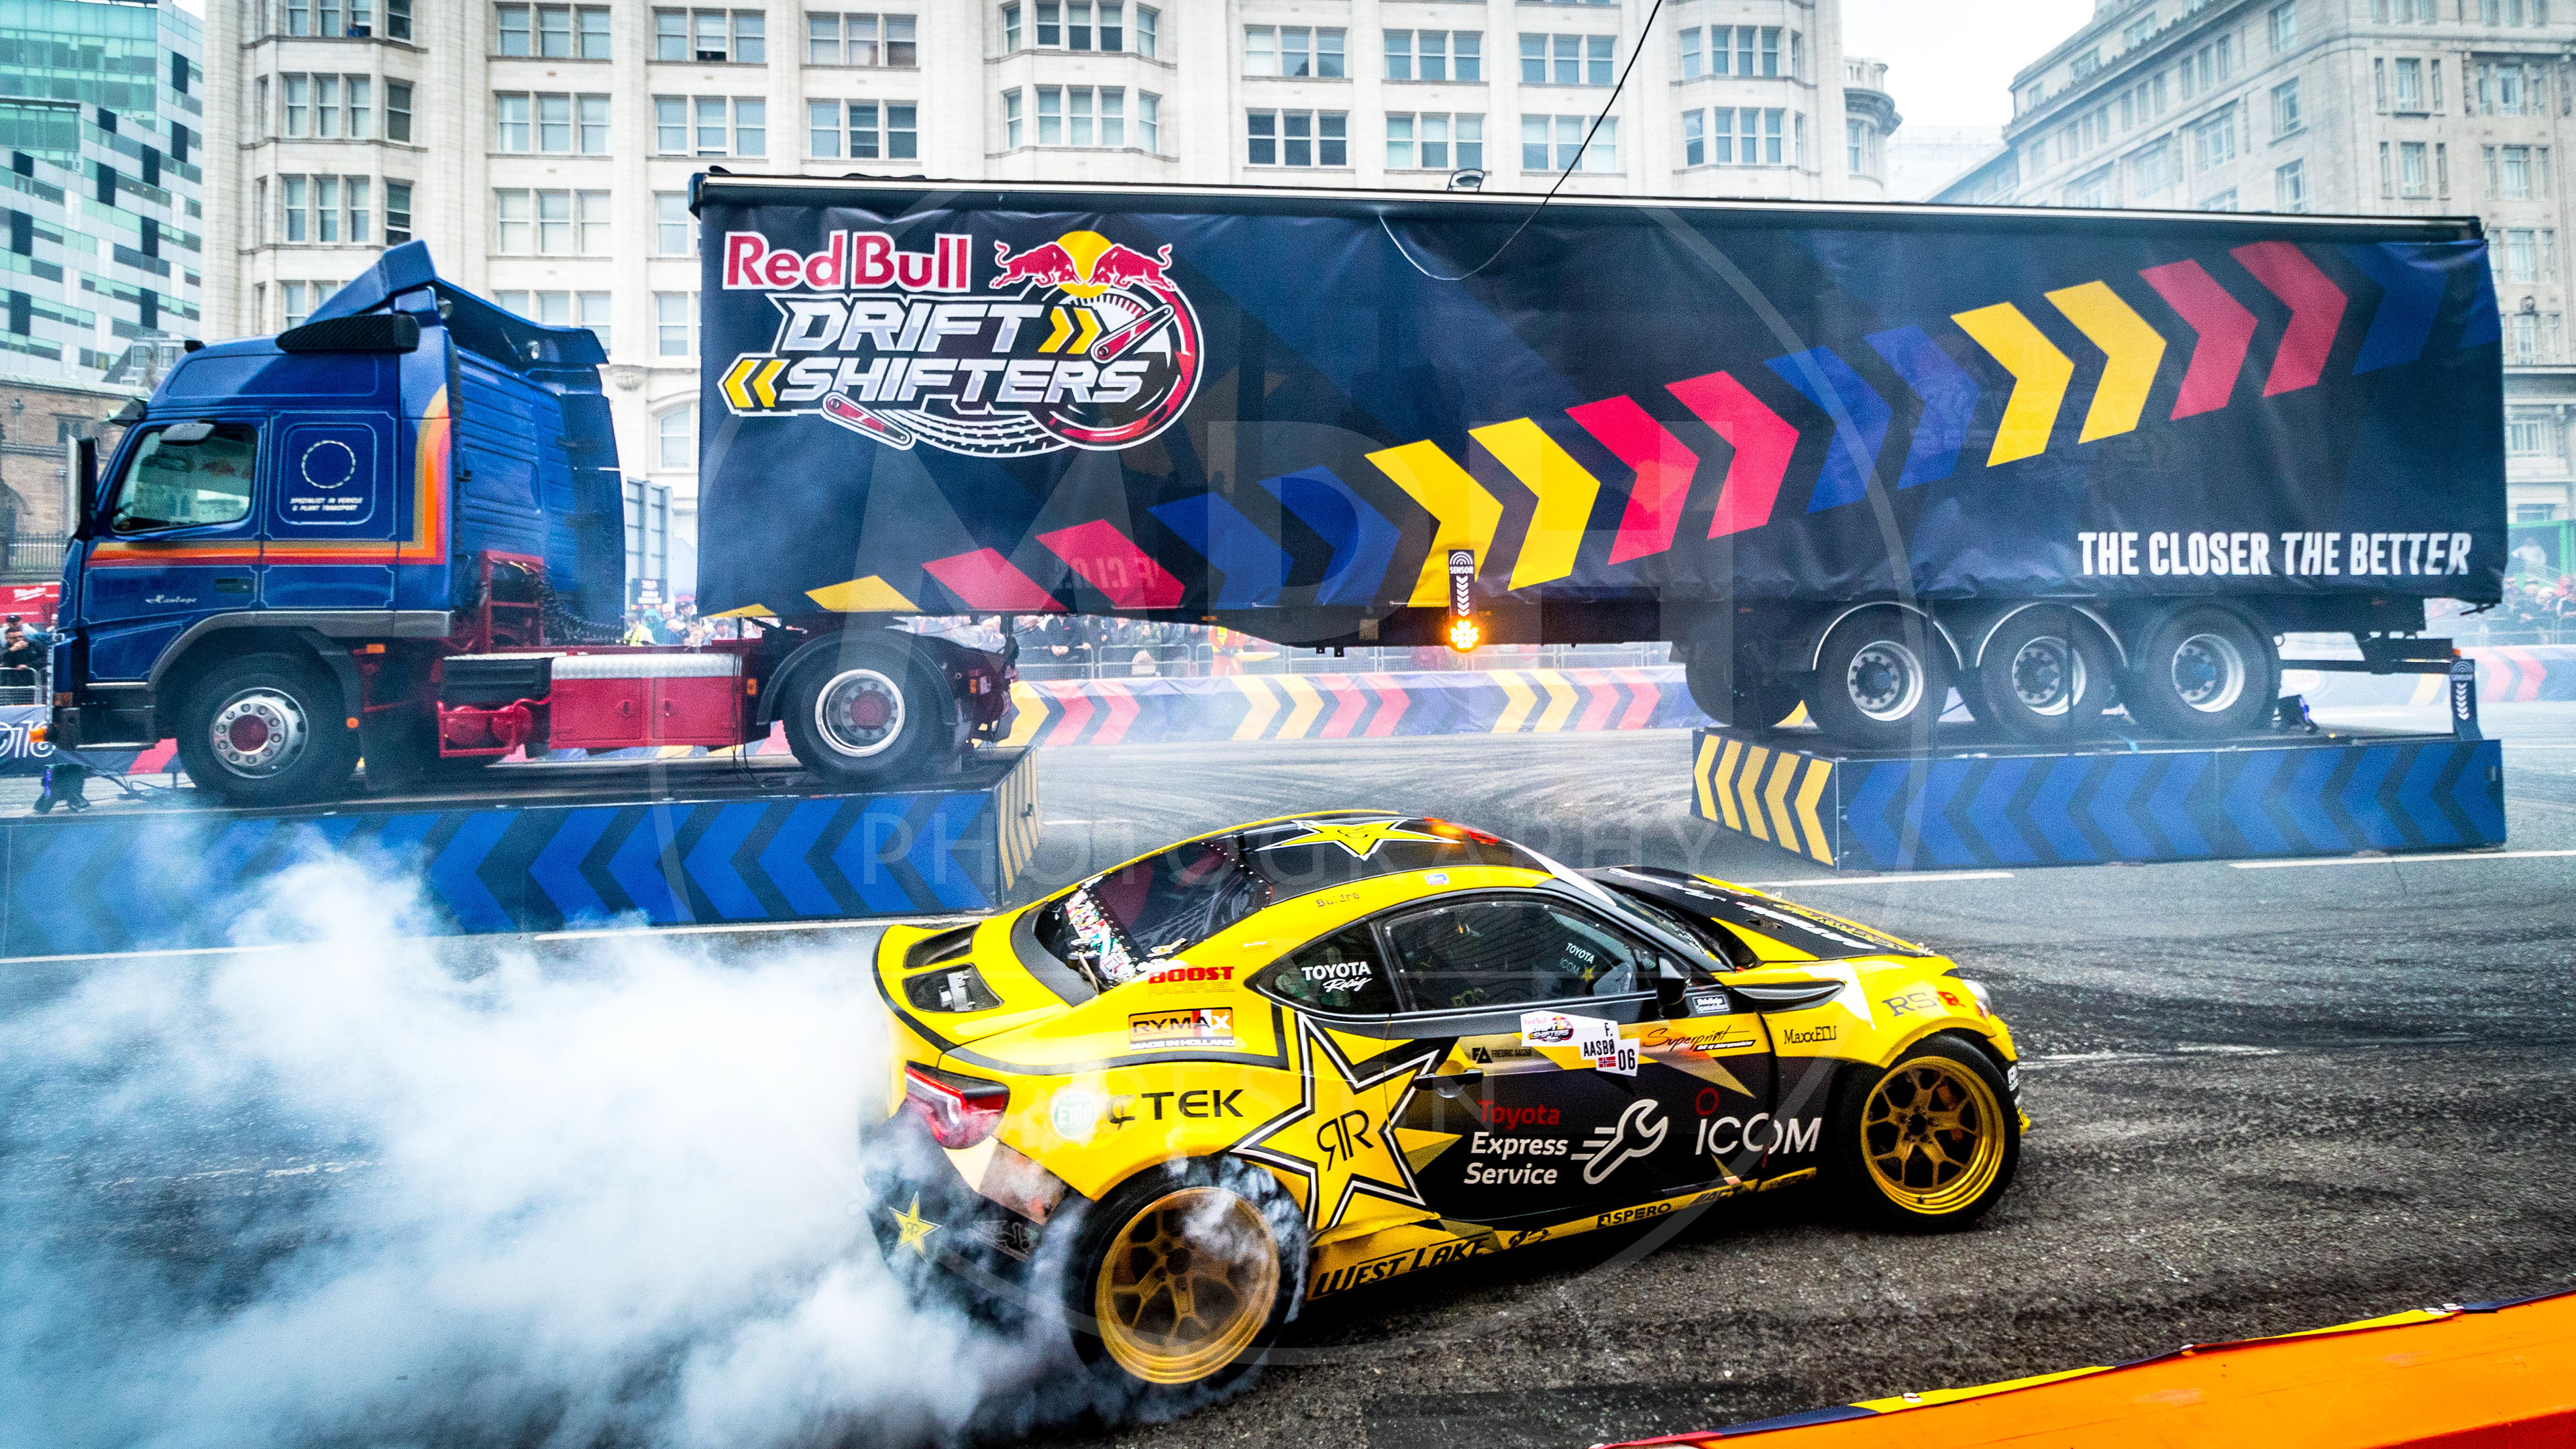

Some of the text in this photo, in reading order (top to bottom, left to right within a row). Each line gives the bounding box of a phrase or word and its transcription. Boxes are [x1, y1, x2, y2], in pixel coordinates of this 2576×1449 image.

[724, 231, 971, 291] Red Bull
[782, 301, 1044, 353] DRIFT
[780, 357, 1150, 402] SHIFTERS
[2078, 531, 2472, 576] THE CLOSER THE BETTER
[1449, 566, 1474, 574] SENSOR
[1566, 943, 1595, 964] TOYOTA
[1148, 966, 1235, 984] BOOST
[1301, 961, 1371, 981] TOYOTA
[1148, 981, 1236, 996] RACEFUEL
[1133, 1015, 1231, 1034] RYMAX
[1533, 1029, 1569, 1038] SHIFTERS
[1604, 1022, 1613, 1036] F.
[1130, 1041, 1165, 1050] MADE
[1583, 1039, 1615, 1057] AASBØ
[1642, 1025, 1749, 1052] Superprint
[1617, 1049, 1635, 1071] 06
[1479, 1099, 1560, 1130] Toyota
[1471, 1132, 1568, 1159] Express
[1464, 1163, 1558, 1185] Service
